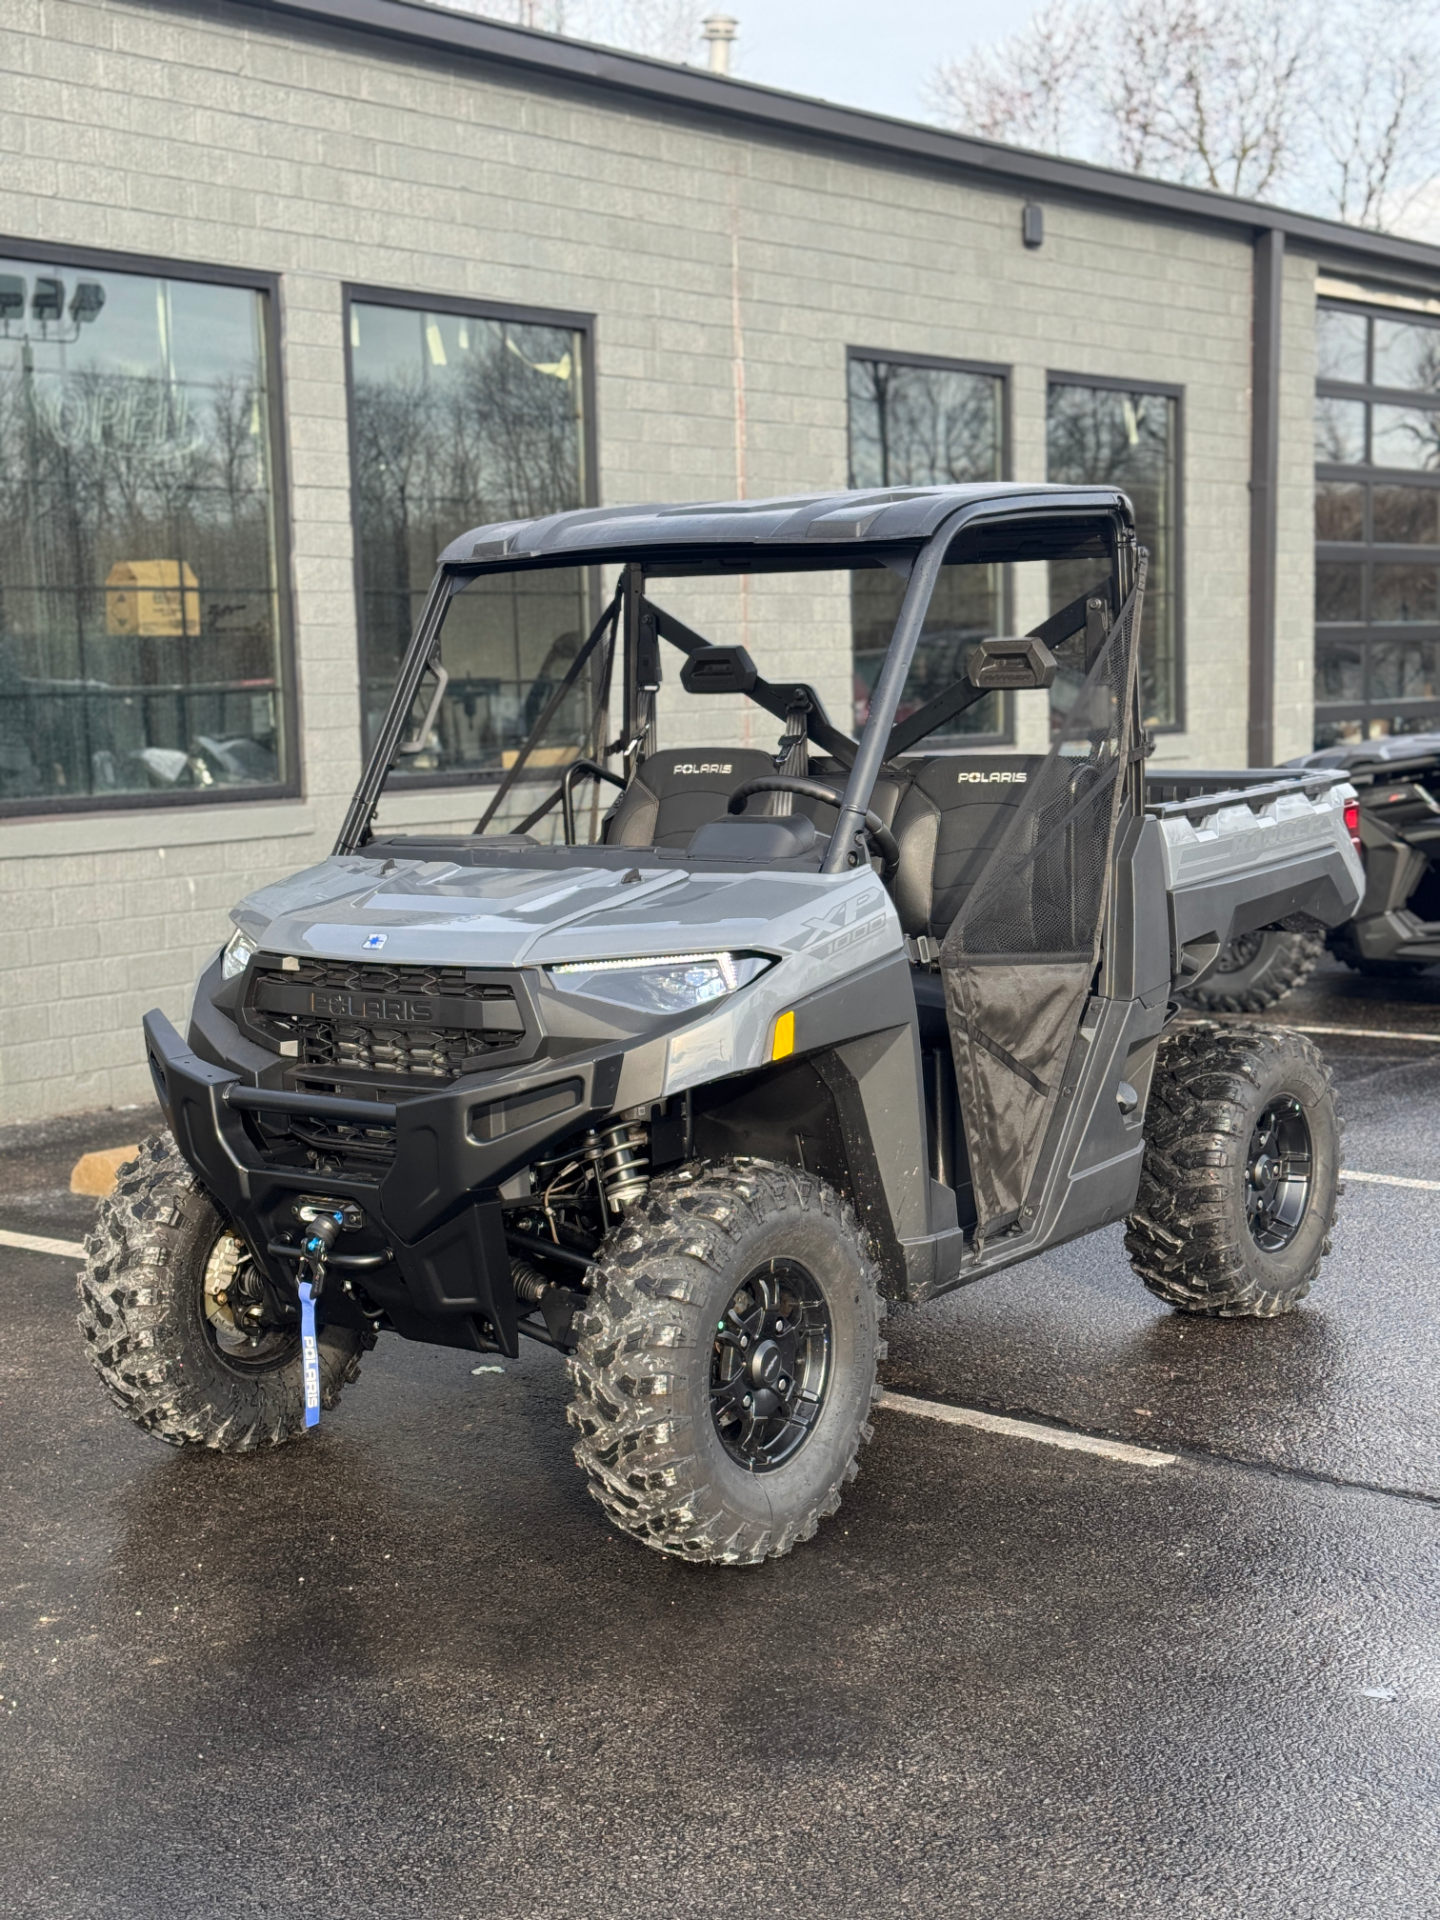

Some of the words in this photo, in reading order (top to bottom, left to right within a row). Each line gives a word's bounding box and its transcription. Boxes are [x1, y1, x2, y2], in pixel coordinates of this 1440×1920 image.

[50, 386, 188, 446] OPEN
[673, 763, 733, 775] POLARIS
[957, 771, 1028, 784] POLARIS
[1231, 814, 1325, 856] RANGER
[800, 886, 882, 950] XP
[826, 912, 886, 956] 1000
[310, 992, 434, 1022] POLARIS
[304, 1336, 318, 1408] POLARIS
